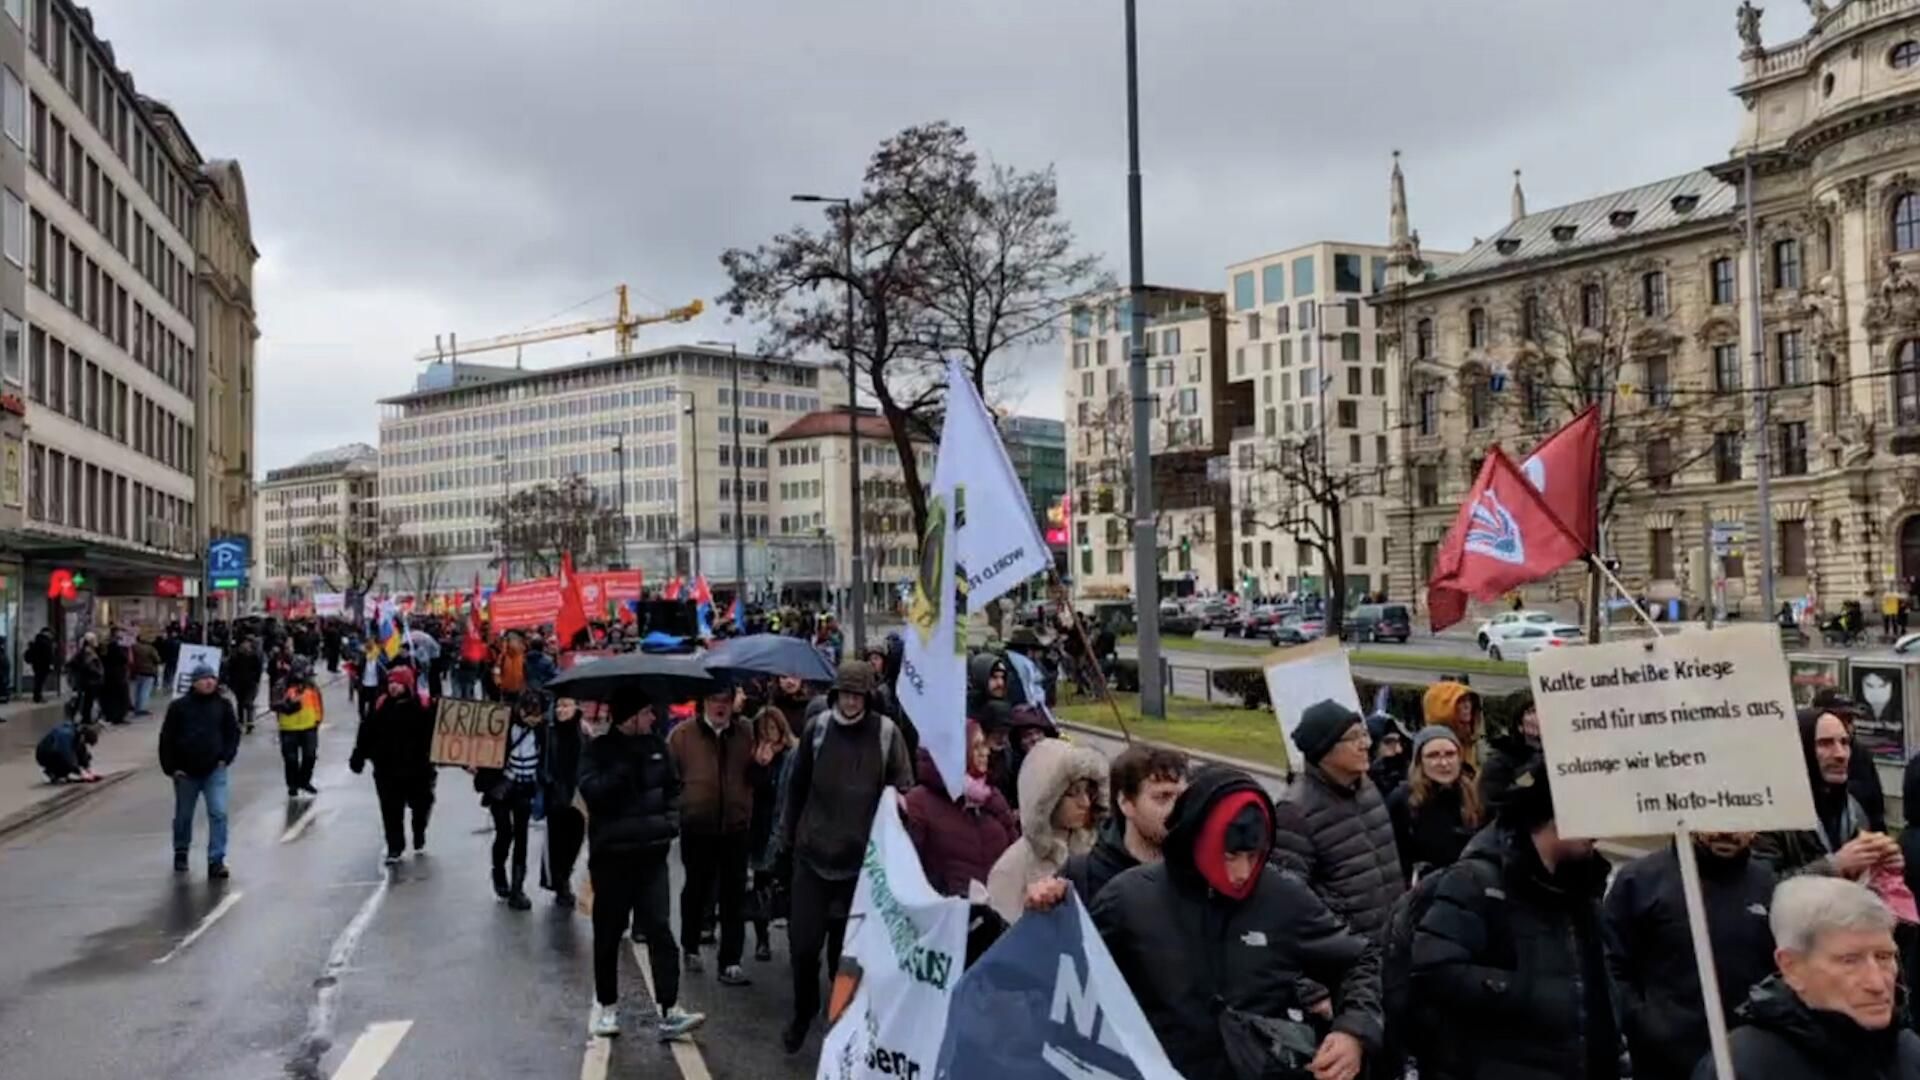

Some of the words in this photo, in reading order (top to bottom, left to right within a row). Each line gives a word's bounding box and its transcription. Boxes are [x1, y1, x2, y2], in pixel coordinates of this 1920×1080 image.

[218, 550, 232, 568] P
[1591, 668, 1619, 689] und
[1674, 657, 1734, 681] Kriege
[438, 700, 505, 737] KRIEG
[1571, 711, 1608, 732] sind
[1610, 707, 1635, 729] für
[1639, 708, 1668, 727] uns
[1671, 701, 1741, 725] niemals
[1557, 757, 1621, 777] solange
[1625, 751, 1650, 770] wir
[1654, 750, 1707, 768] leben
[1636, 792, 1661, 813] im
